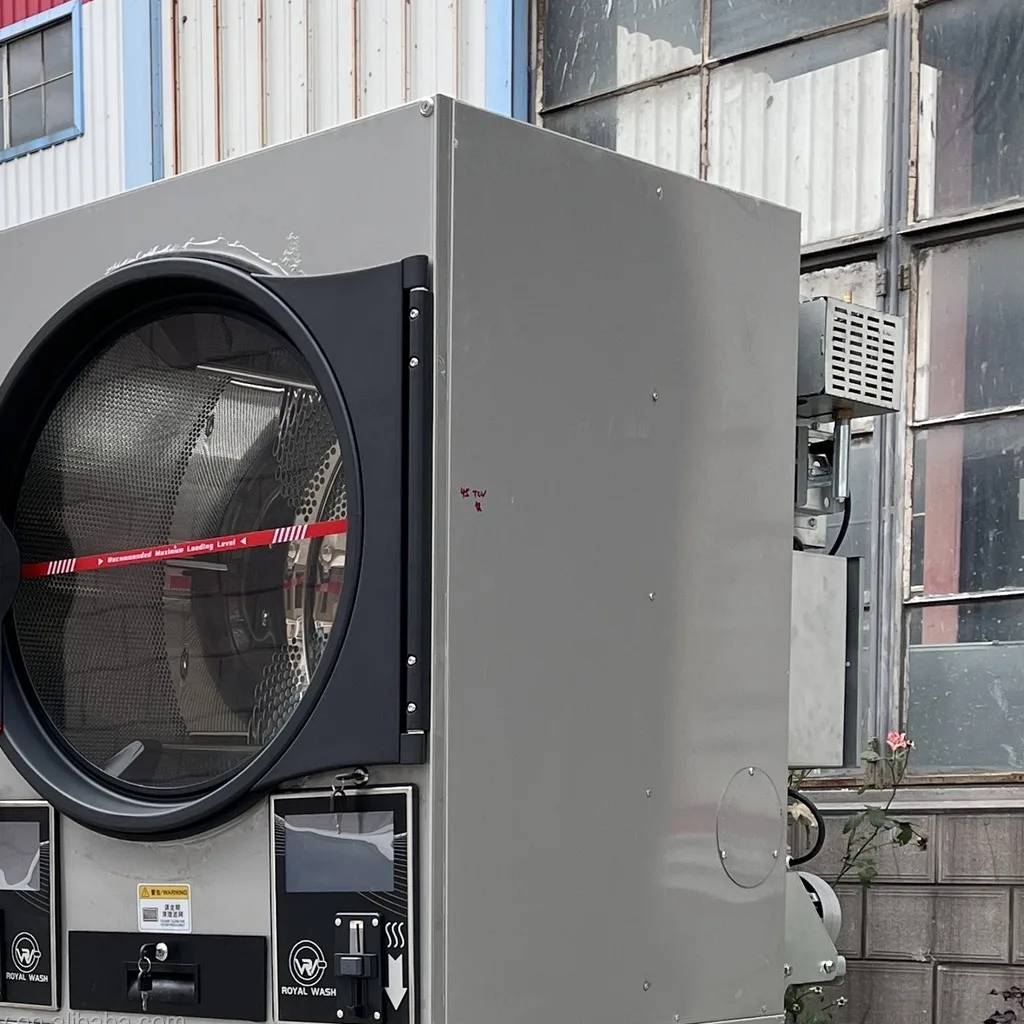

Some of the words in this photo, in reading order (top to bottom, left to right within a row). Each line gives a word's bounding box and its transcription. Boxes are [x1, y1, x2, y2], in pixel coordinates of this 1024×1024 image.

[107, 551, 152, 563] Recommended
[155, 546, 184, 557] Maximum
[187, 543, 214, 552] Loading
[217, 539, 236, 548] Level
[6, 972, 27, 981] ROYAL
[28, 974, 48, 982] WASH
[281, 986, 308, 996] ROYAL
[310, 987, 337, 997] WASH
